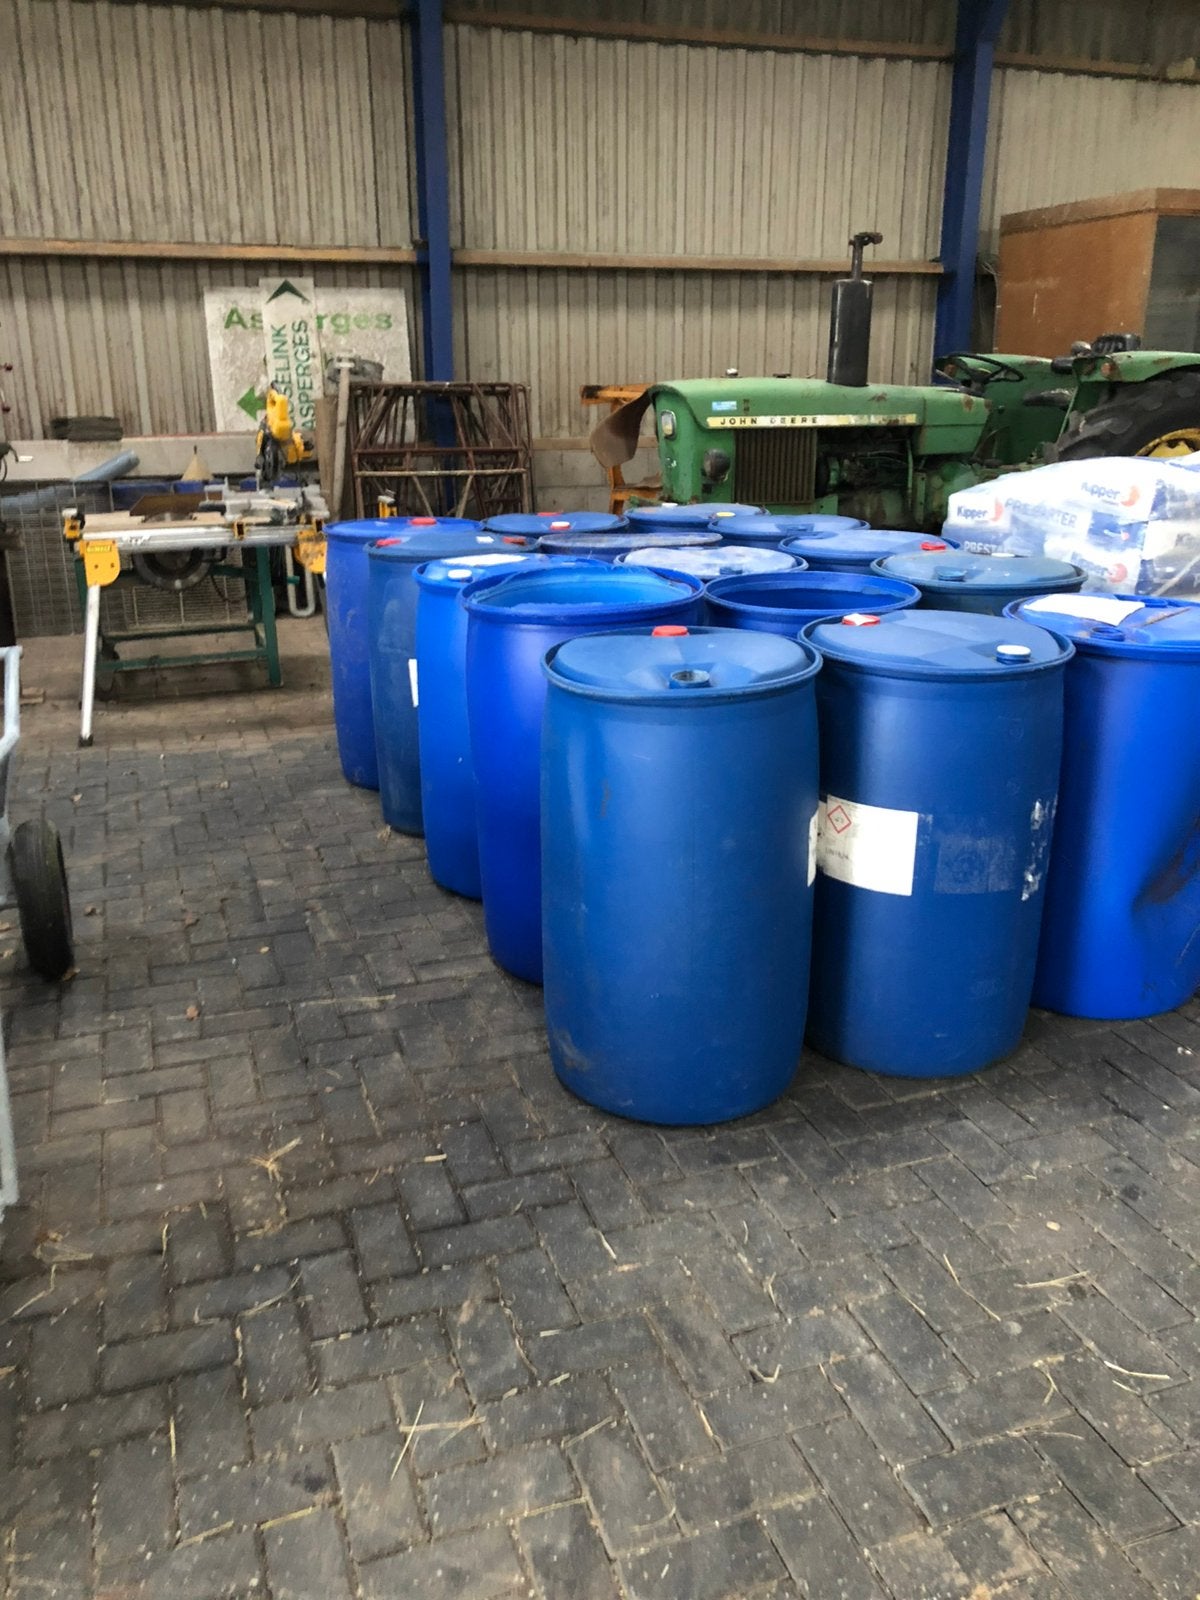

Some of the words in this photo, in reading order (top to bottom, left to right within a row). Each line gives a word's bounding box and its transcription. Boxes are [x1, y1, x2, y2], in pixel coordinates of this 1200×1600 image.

[224, 306, 393, 335] Asrges
[291, 319, 316, 431] ASPERGES
[721, 418, 757, 426] JOHN
[770, 416, 818, 425] DEERE
[957, 505, 988, 519] Kipper
